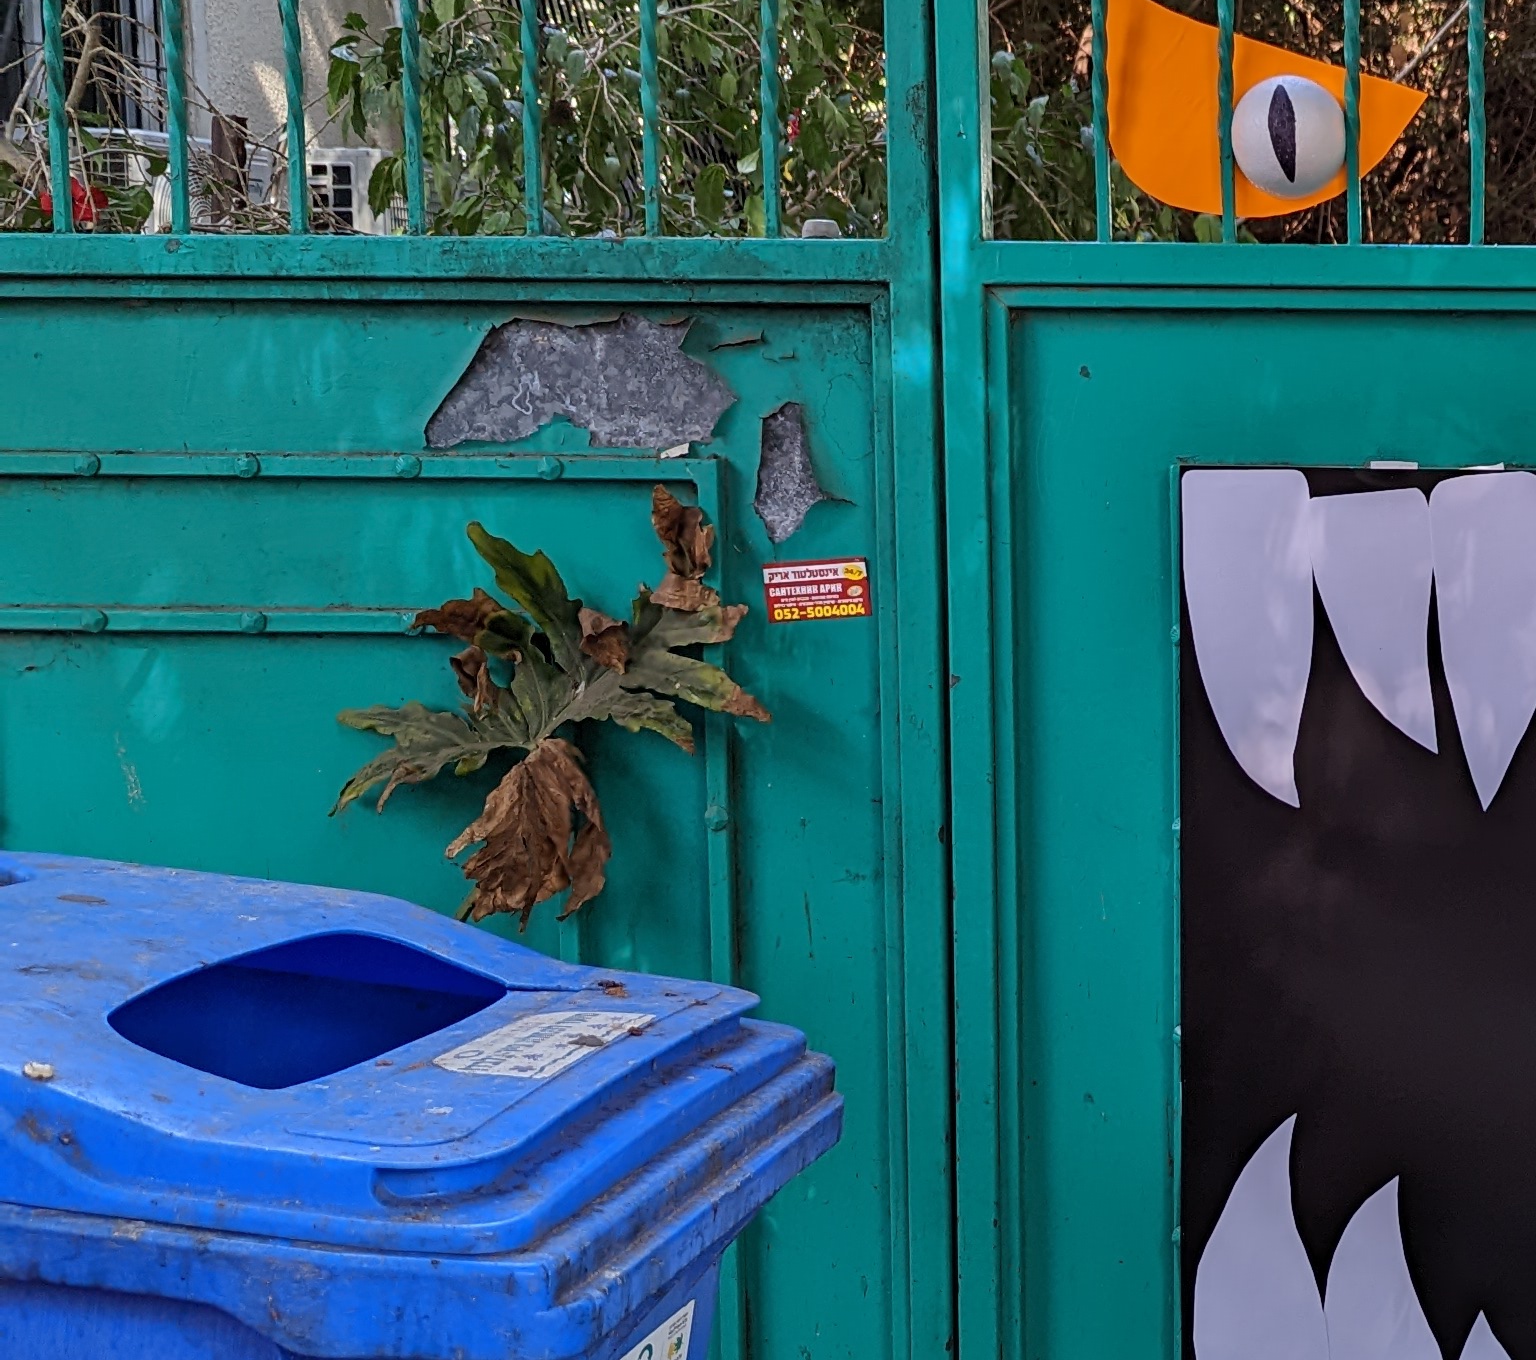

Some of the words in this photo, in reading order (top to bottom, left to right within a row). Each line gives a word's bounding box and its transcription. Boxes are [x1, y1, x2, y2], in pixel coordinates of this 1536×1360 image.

[768, 571, 790, 582] אריק
[791, 568, 839, 580] אינסטלטור
[769, 584, 818, 597] САНТЕХНИК
[819, 583, 843, 593] АРИК
[774, 603, 865, 621] 052-5004004
